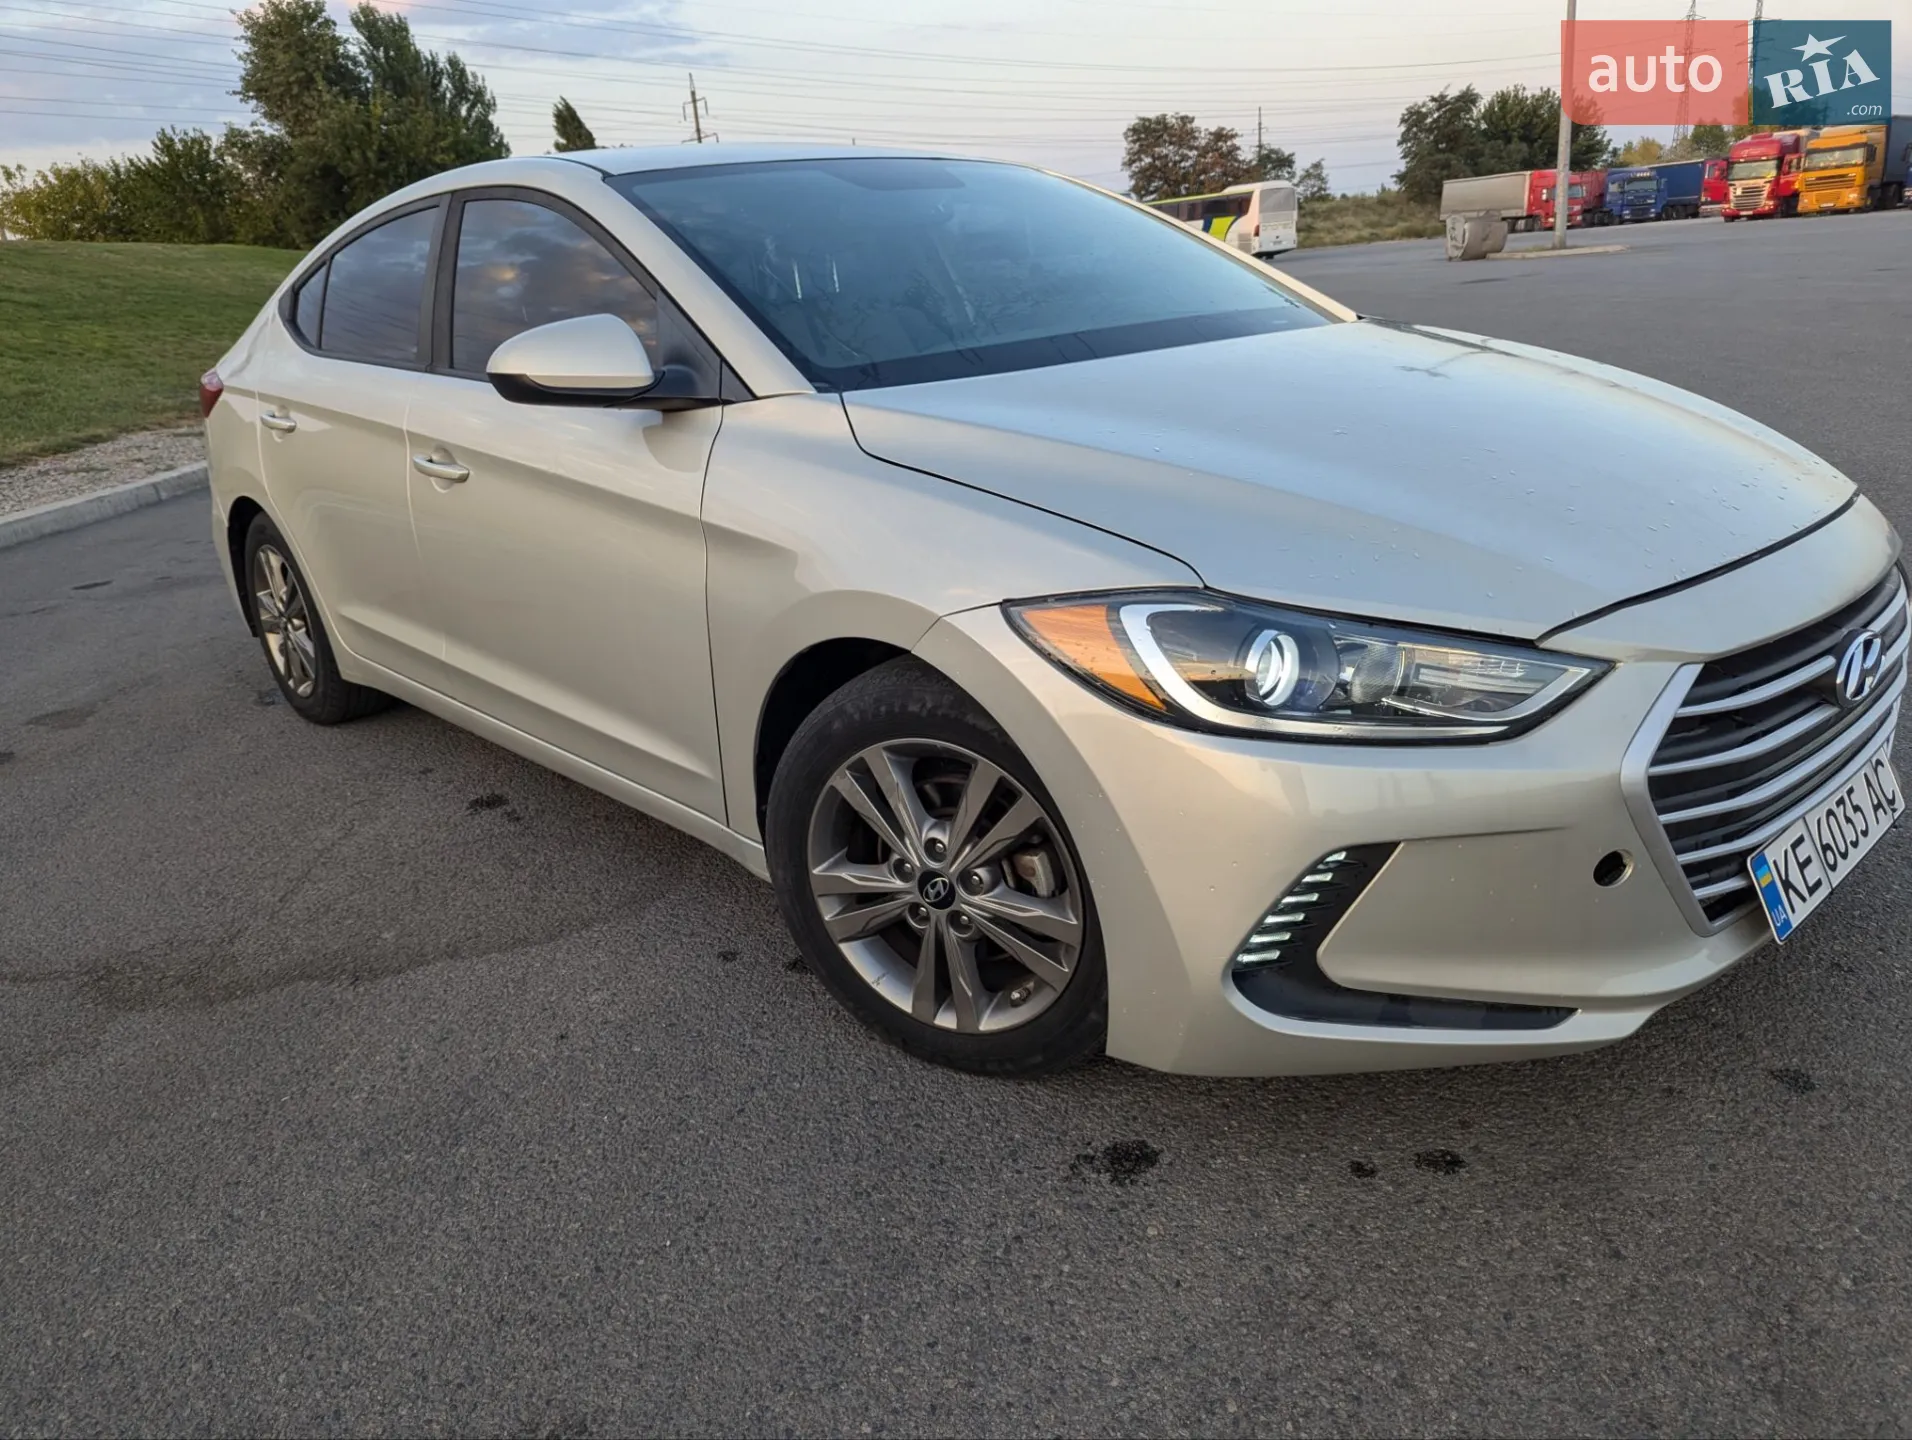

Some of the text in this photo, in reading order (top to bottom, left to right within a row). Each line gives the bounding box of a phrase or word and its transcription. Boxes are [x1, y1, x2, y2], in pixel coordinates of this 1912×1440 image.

[1773, 758, 1896, 914] KE 6035 AC
[1772, 904, 1787, 927] UA
